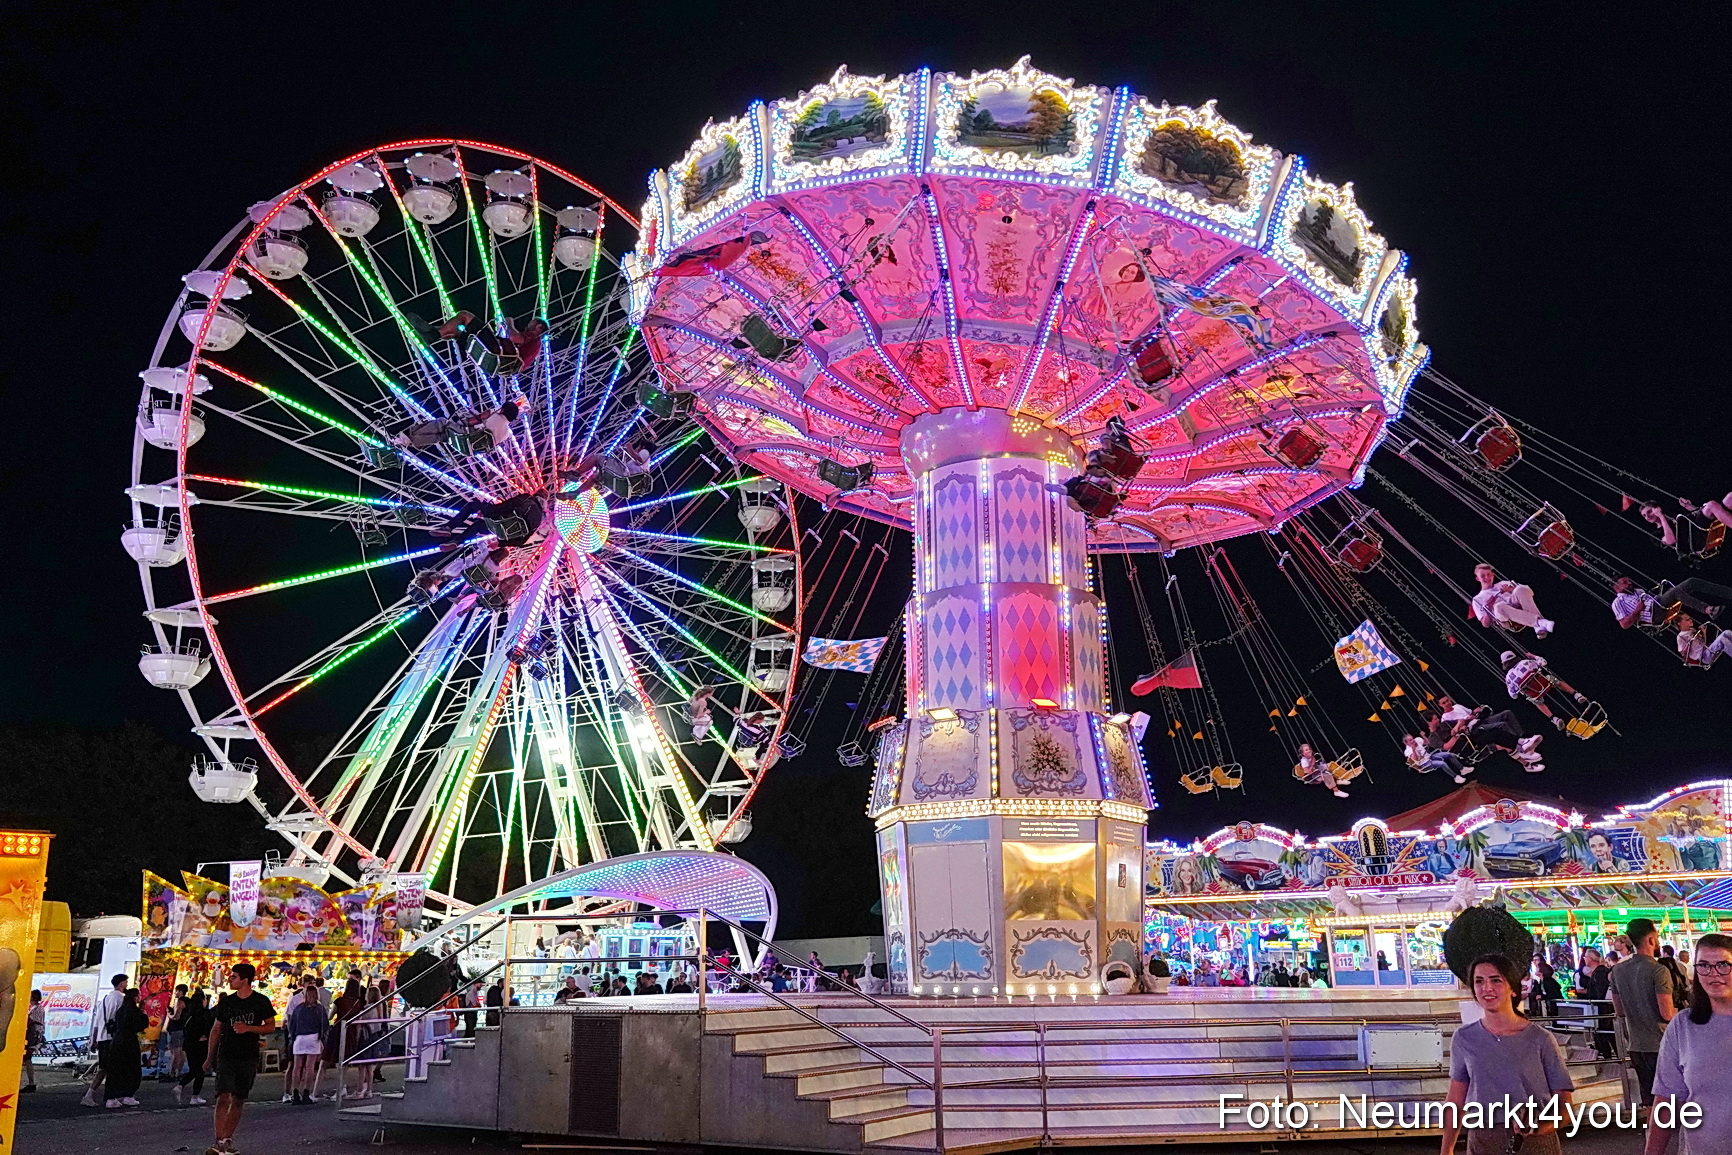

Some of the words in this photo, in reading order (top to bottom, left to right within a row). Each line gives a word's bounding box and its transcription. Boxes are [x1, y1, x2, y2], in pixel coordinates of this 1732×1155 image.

[1374, 875, 1385, 886] OF
[231, 889, 258, 904] ANGELN
[397, 899, 423, 911] ANGELN
[1339, 957, 1353, 967] 112
[40, 984, 92, 1011] Traveller
